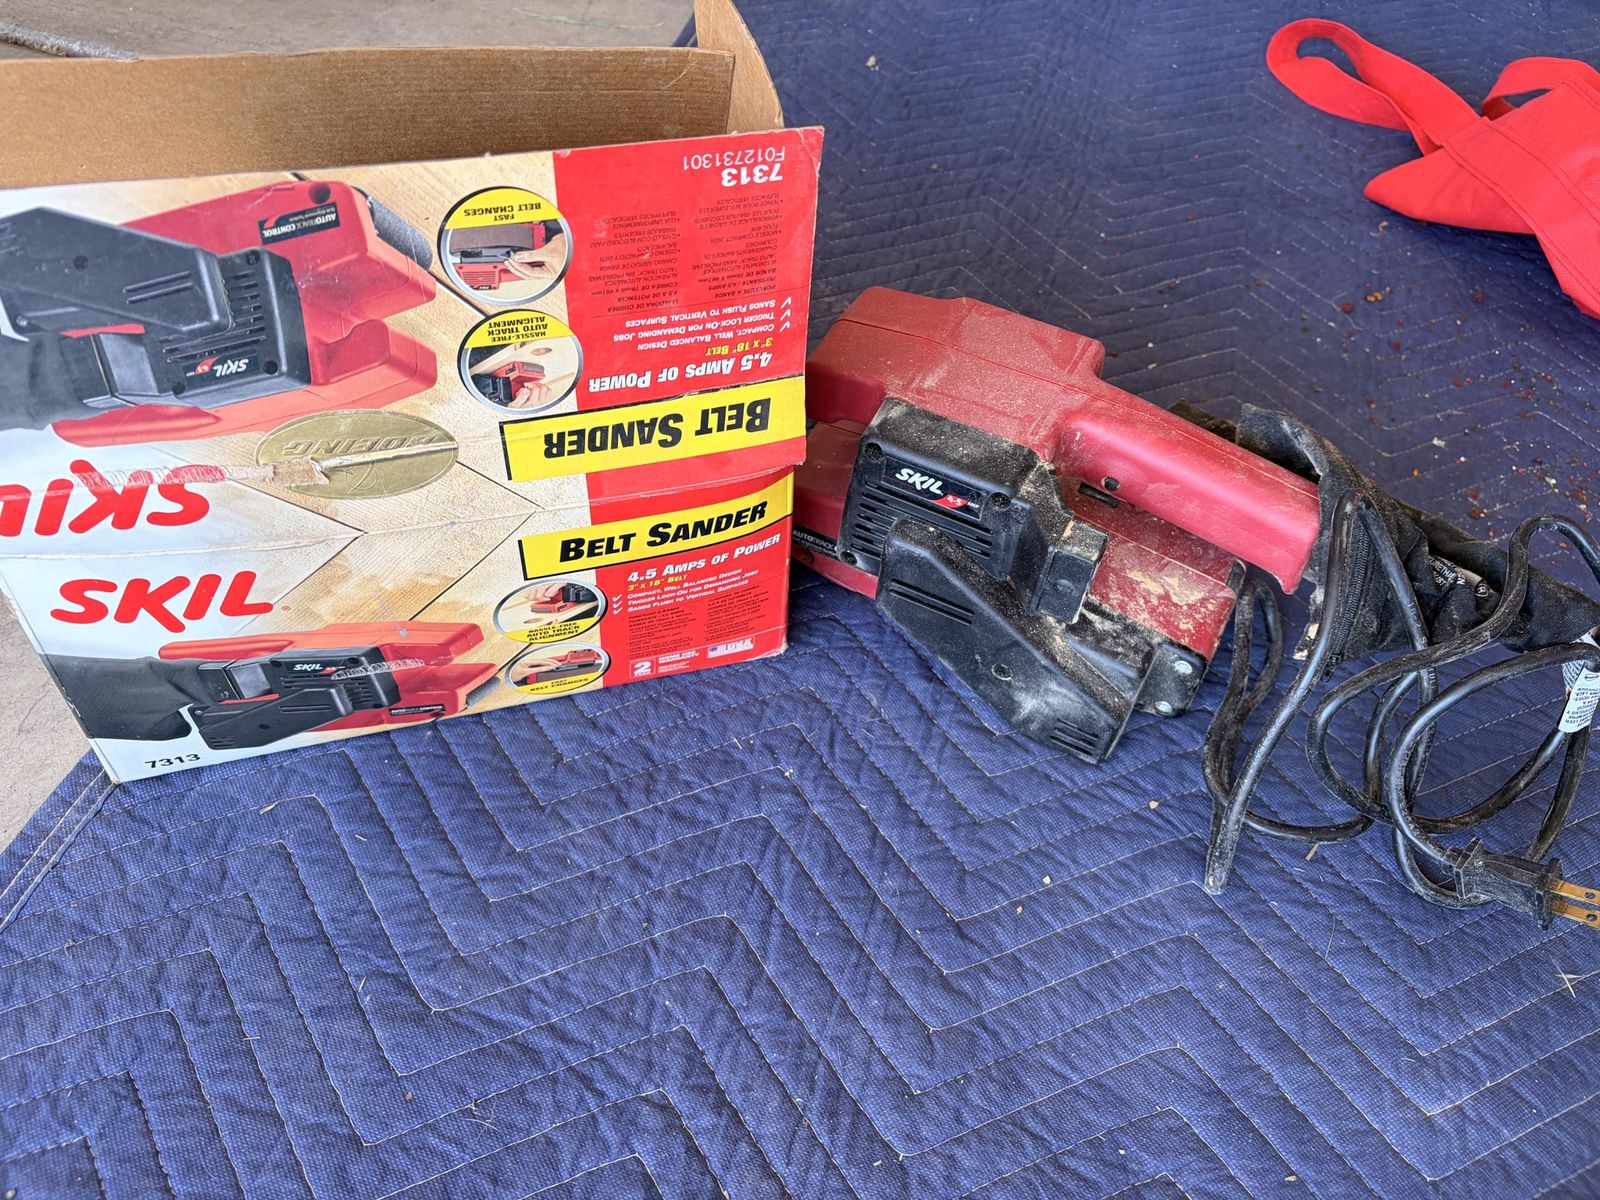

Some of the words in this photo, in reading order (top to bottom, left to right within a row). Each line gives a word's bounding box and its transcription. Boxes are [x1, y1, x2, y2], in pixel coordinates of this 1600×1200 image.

[683, 145, 785, 171] F012731301
[721, 163, 784, 187] 7313
[463, 206, 514, 217] CHANGES
[517, 202, 542, 211] BELT
[262, 223, 296, 238] CONTROL
[721, 304, 747, 316] FLUSH
[748, 299, 776, 309] SANDS
[670, 309, 707, 322] VERTICAL
[709, 308, 720, 317] TO
[743, 312, 775, 324] TRIGGER
[488, 316, 546, 329] ALIGNMENT
[523, 323, 548, 333] AUTO
[625, 315, 668, 328] SURFACES
[687, 323, 703, 332] FOR
[705, 317, 742, 329] LOCK-ON
[487, 327, 520, 336] TRACK
[637, 325, 686, 339] DEMANDING
[713, 330, 734, 340] WELL
[735, 323, 775, 337] COMPACT,
[490, 331, 546, 343] HASSLE-FREE
[613, 332, 636, 342] JOBS
[669, 334, 711, 347] BALANCED
[760, 336, 774, 348] 3"
[637, 340, 667, 351] DESIGN
[705, 344, 730, 356] BELT
[731, 341, 750, 353] 18"
[685, 357, 736, 378] AMPS
[739, 351, 773, 371] 4.5
[213, 359, 249, 377] SKIL
[657, 366, 679, 382] OF
[588, 371, 652, 392] POWER
[695, 397, 771, 436] BELT
[543, 413, 684, 459] SANDER
[281, 435, 437, 458] BOEING
[895, 468, 942, 495] SKIL
[0, 460, 225, 537] SKIL
[559, 533, 636, 563] BELT
[646, 500, 768, 547] SANDER
[793, 529, 835, 550] AUTOTRACK
[627, 568, 657, 582] 4.5
[662, 559, 707, 576] AMPS
[711, 553, 729, 565] OF
[733, 533, 781, 558] POWER
[627, 589, 663, 600] COMPACT,
[664, 584, 681, 592] WELL
[683, 576, 718, 588] BALANCED
[719, 569, 742, 579] DESIGN
[667, 574, 688, 583] BELT
[628, 596, 655, 606] TRIGGER
[657, 590, 688, 600] LOCK-ON
[688, 586, 702, 594] FOR
[704, 575, 741, 590] DEMANDING
[742, 569, 759, 579] JOBS
[50, 570, 274, 633] SKIL
[627, 604, 652, 612] SANDS
[652, 599, 674, 607] FLUSH
[686, 589, 716, 601] VERTICAL
[717, 579, 749, 593] SURFACES
[529, 629, 579, 641] ALIGNMENT
[552, 625, 580, 633] TRACK
[634, 661, 651, 671] 2
[144, 753, 200, 769] 7313
